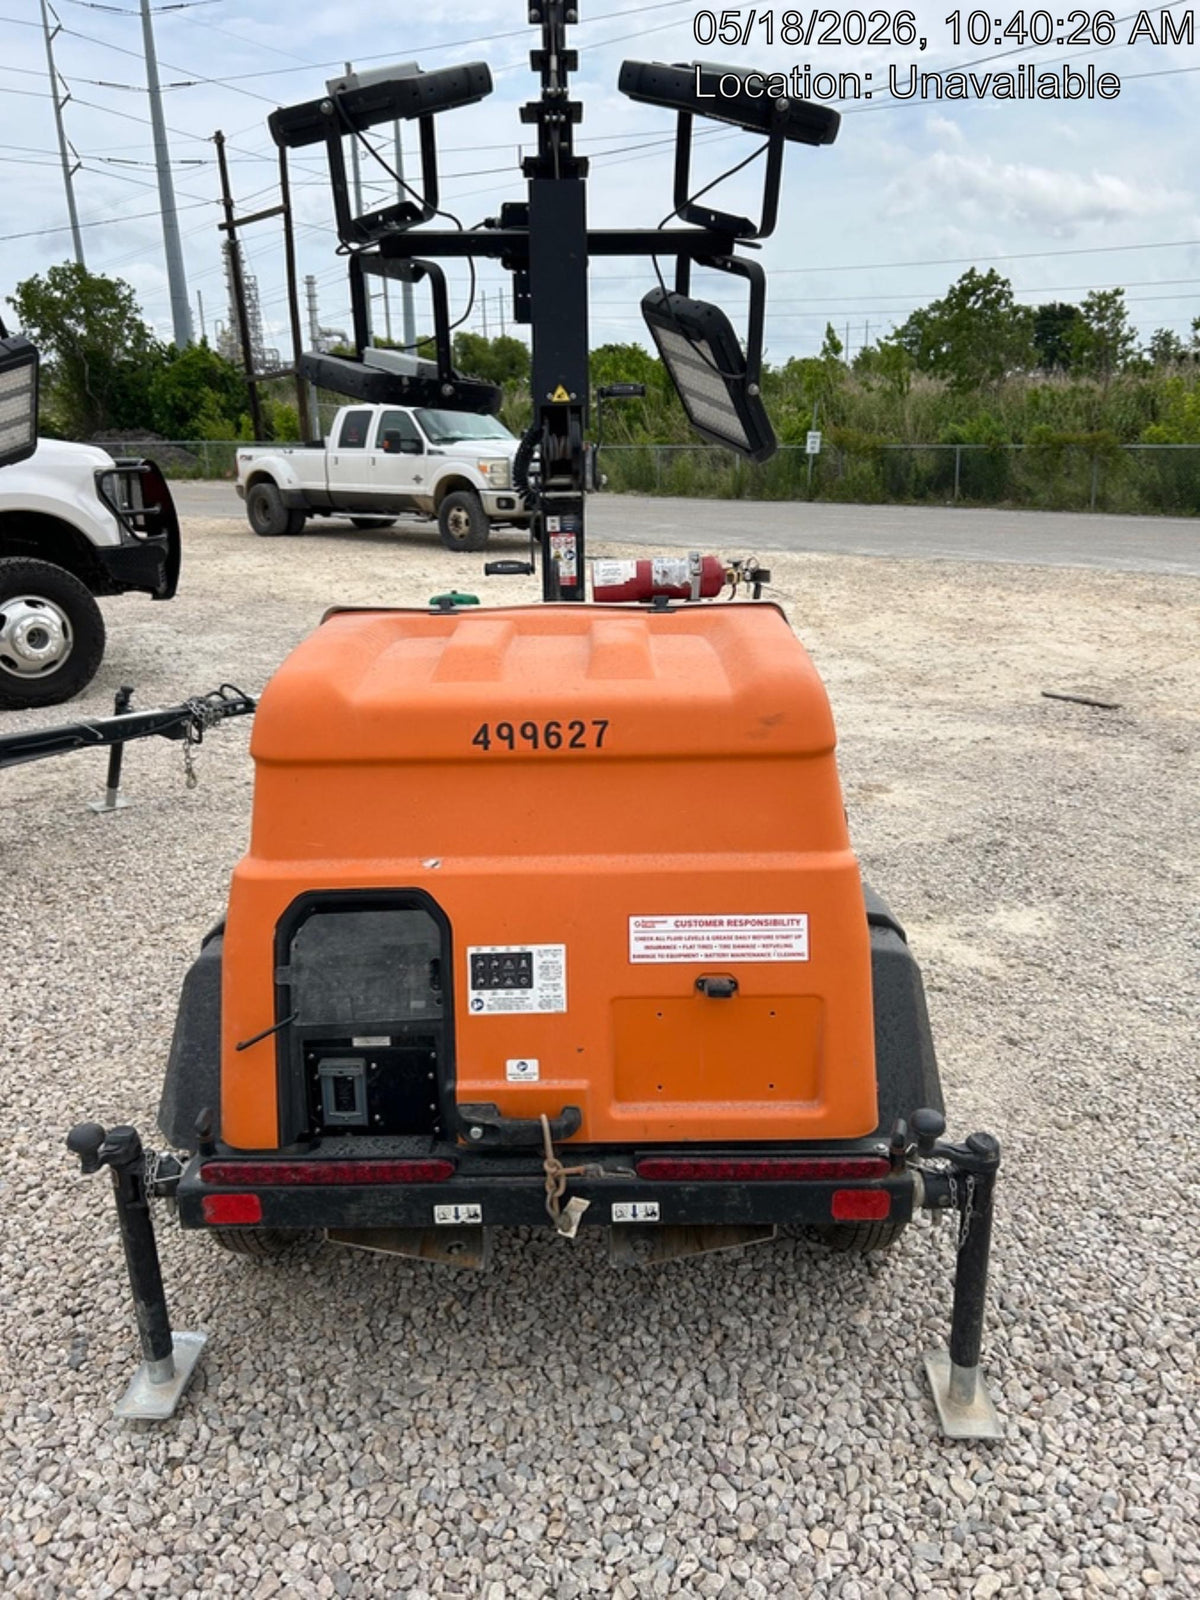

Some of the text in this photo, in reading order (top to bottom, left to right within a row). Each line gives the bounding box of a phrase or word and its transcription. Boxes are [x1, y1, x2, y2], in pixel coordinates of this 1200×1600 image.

[472, 720, 609, 750] 499627
[673, 919, 724, 928] CUSTOMER
[726, 918, 802, 927] RESPONSIBILITY
